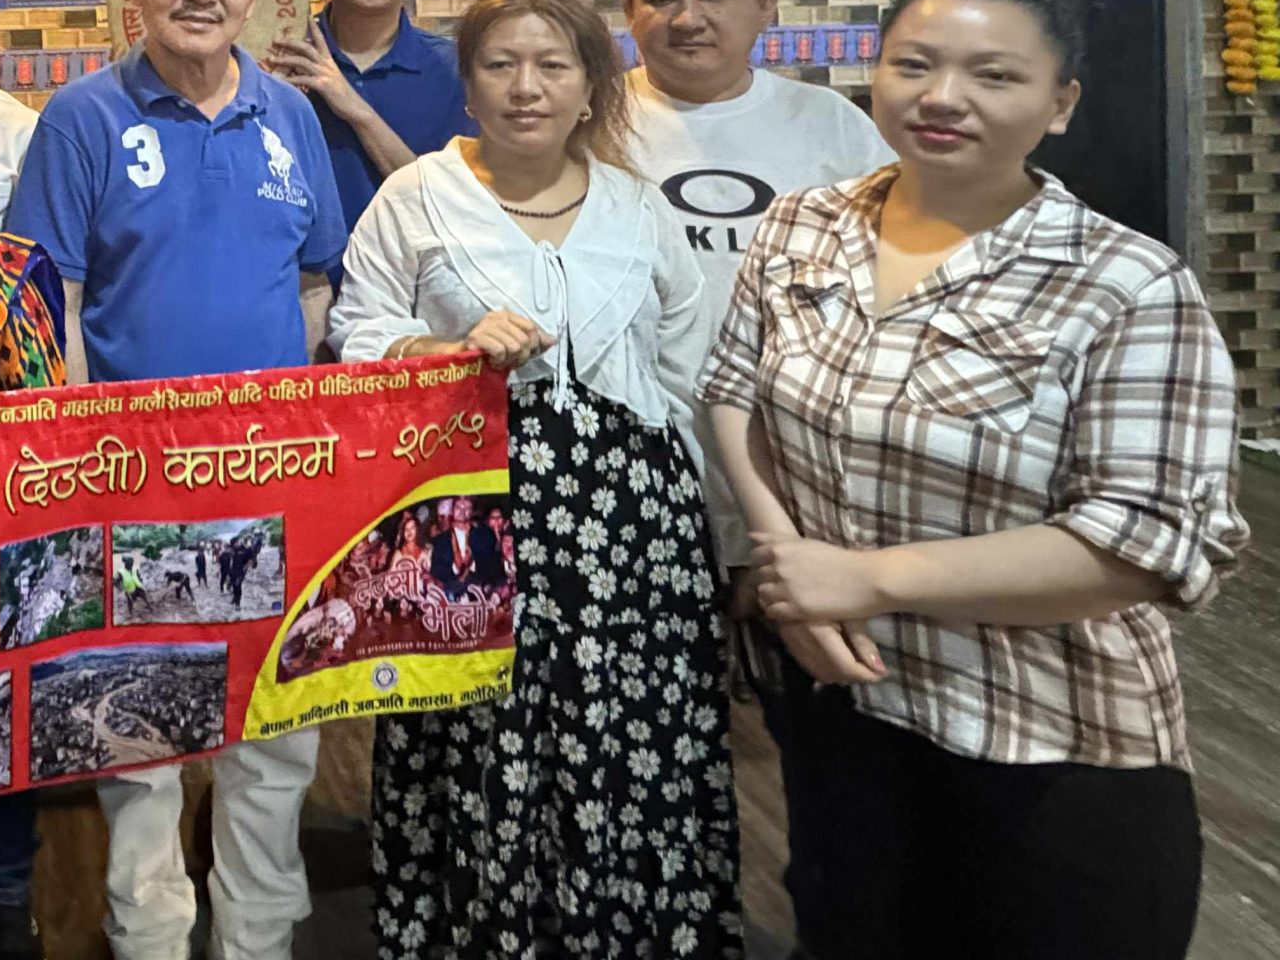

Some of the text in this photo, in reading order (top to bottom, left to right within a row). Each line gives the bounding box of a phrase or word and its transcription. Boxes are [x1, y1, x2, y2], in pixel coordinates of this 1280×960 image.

[122, 124, 166, 188] 3
[257, 187, 284, 201] POLO
[4, 435, 148, 515] (देउसी)
[162, 423, 340, 490] कार्यक्रम
[393, 409, 487, 465] २०२५
